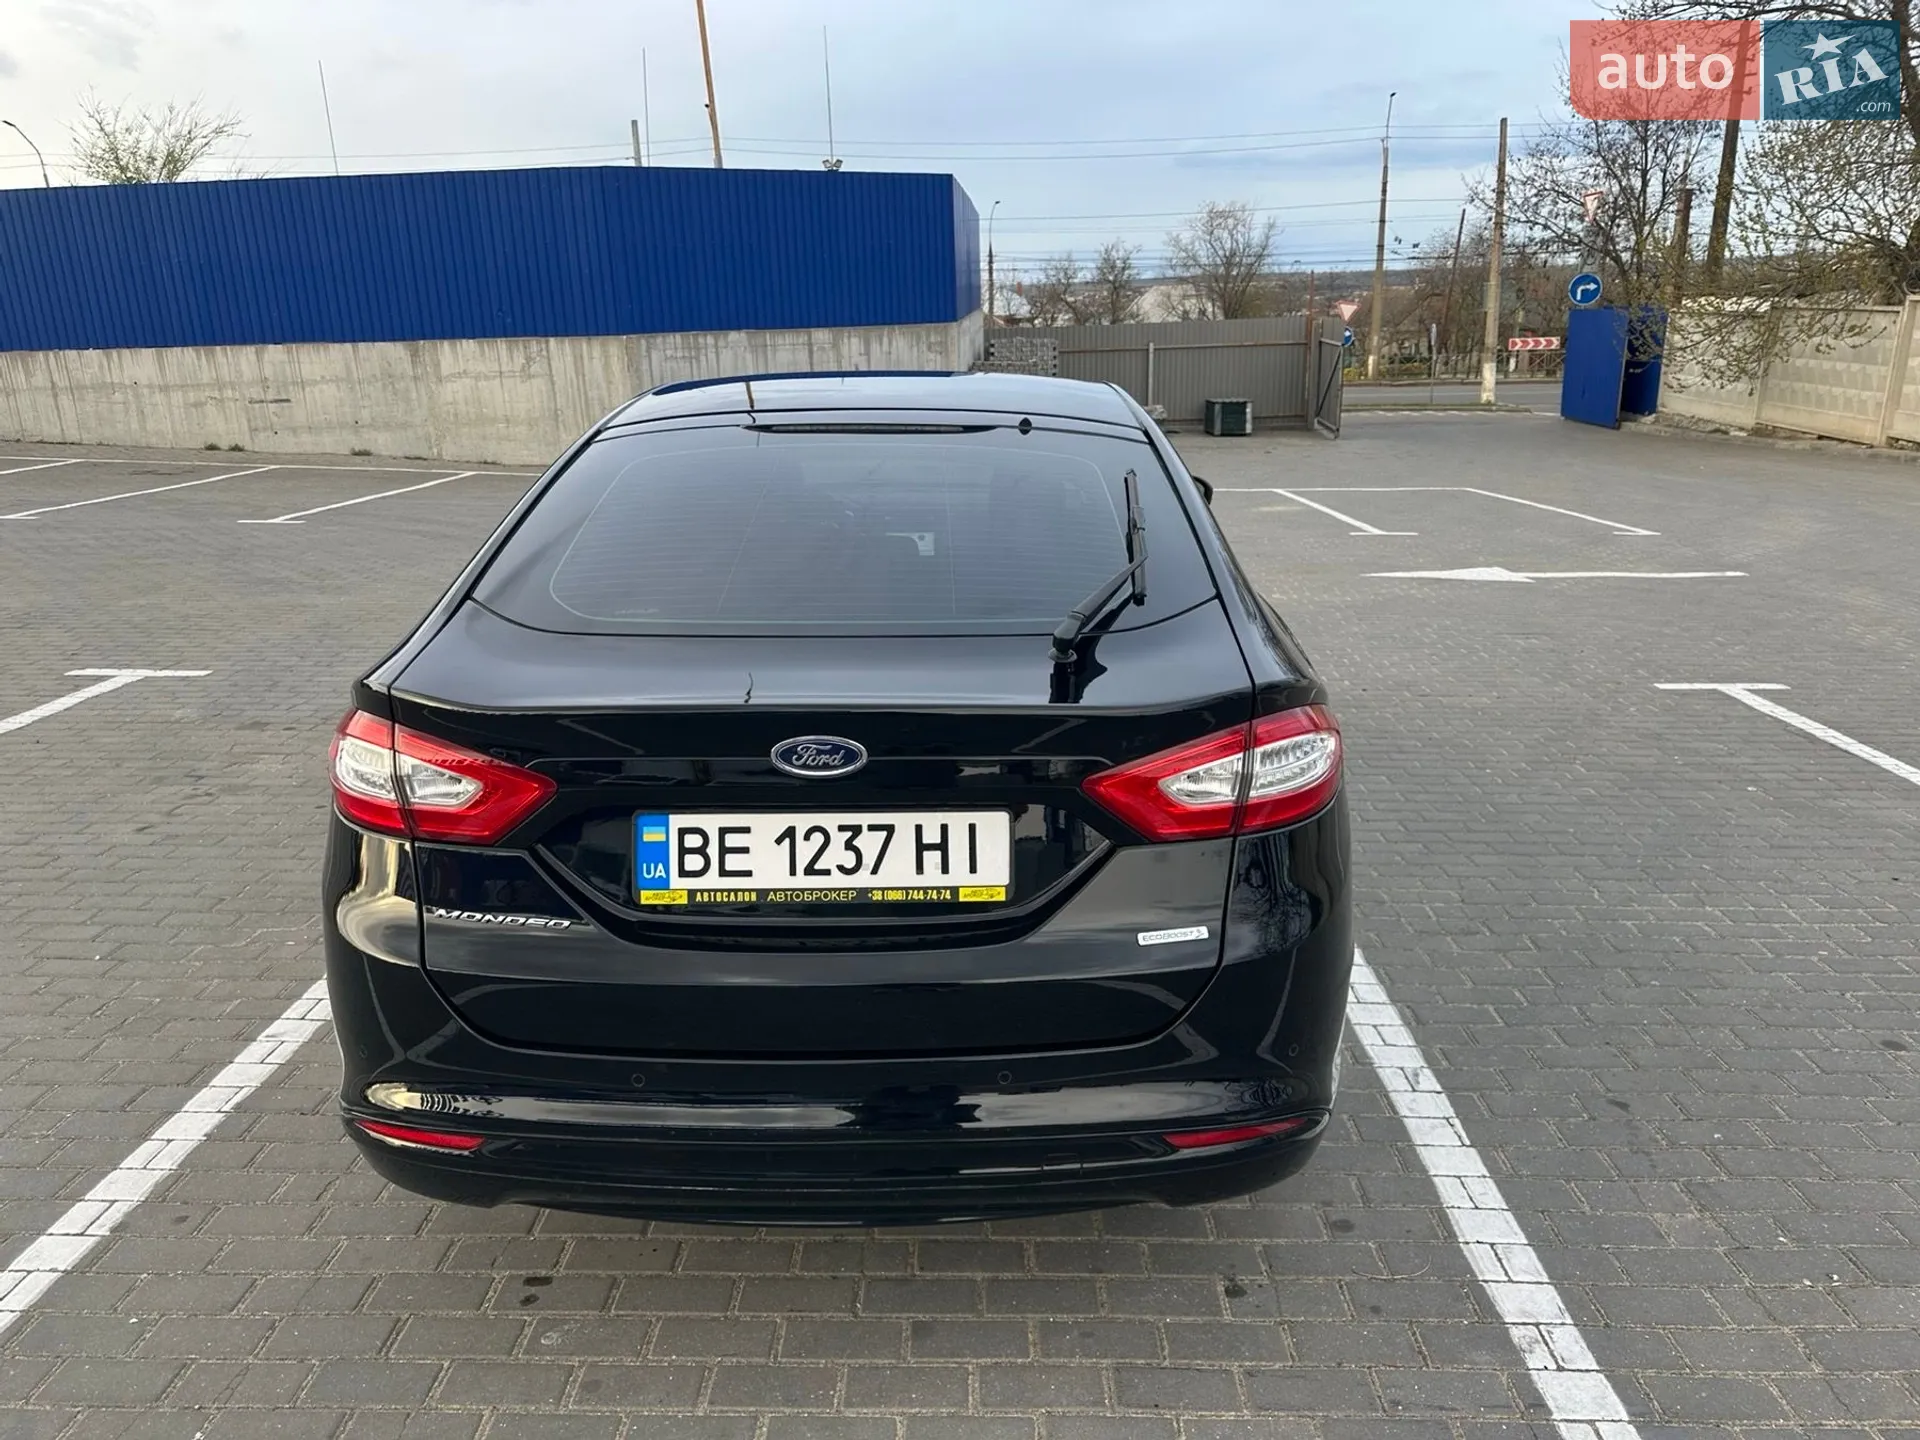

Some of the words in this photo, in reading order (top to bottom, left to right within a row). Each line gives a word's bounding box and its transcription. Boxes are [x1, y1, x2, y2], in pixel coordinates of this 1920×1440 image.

[792, 743, 846, 766] Ford
[677, 826, 753, 878] BE
[774, 824, 896, 876] 1237
[915, 823, 978, 875] HI
[643, 862, 667, 879] UA
[695, 890, 758, 902] АВТОСАЛОН
[767, 890, 857, 902] АВТОБРОКЕР
[434, 908, 572, 930] MONDEO
